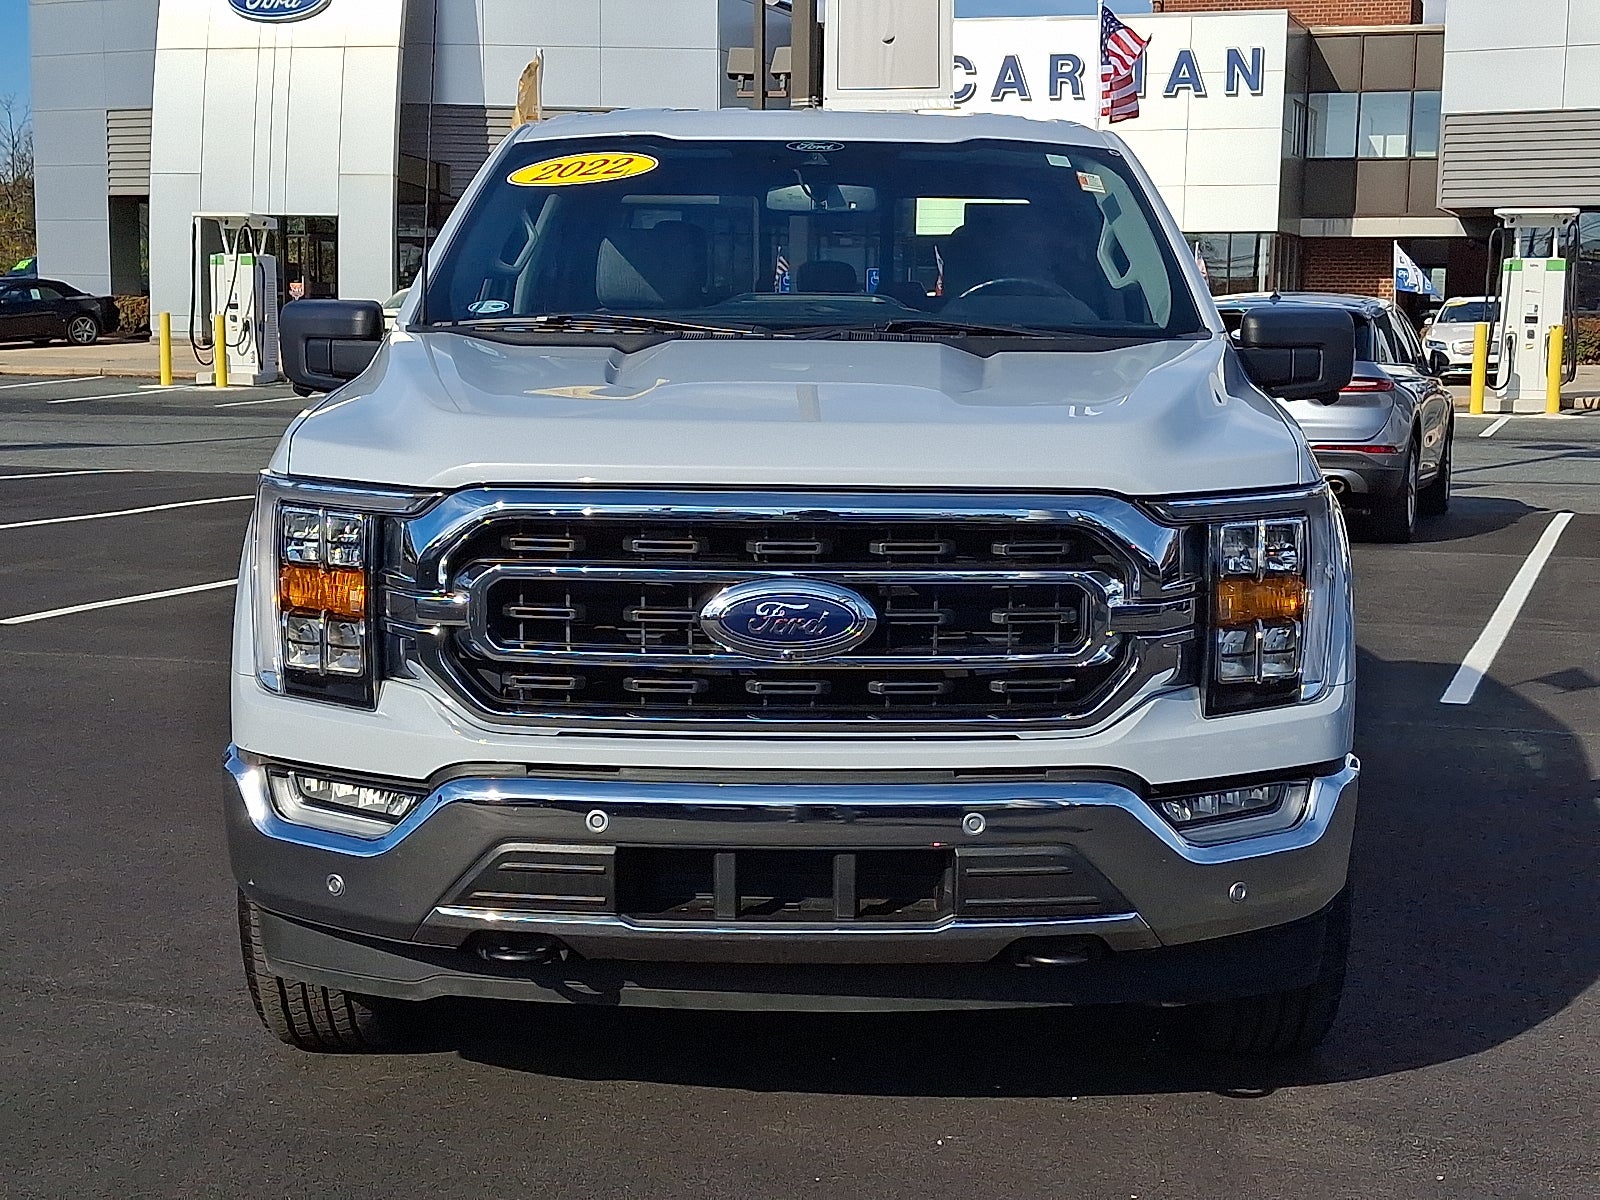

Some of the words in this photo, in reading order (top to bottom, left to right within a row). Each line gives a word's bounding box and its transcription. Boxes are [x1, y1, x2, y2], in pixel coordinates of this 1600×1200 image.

[952, 47, 1265, 101] CARAN
[796, 142, 834, 150] Ford
[530, 157, 634, 181] 2022
[747, 601, 829, 635] Ford
